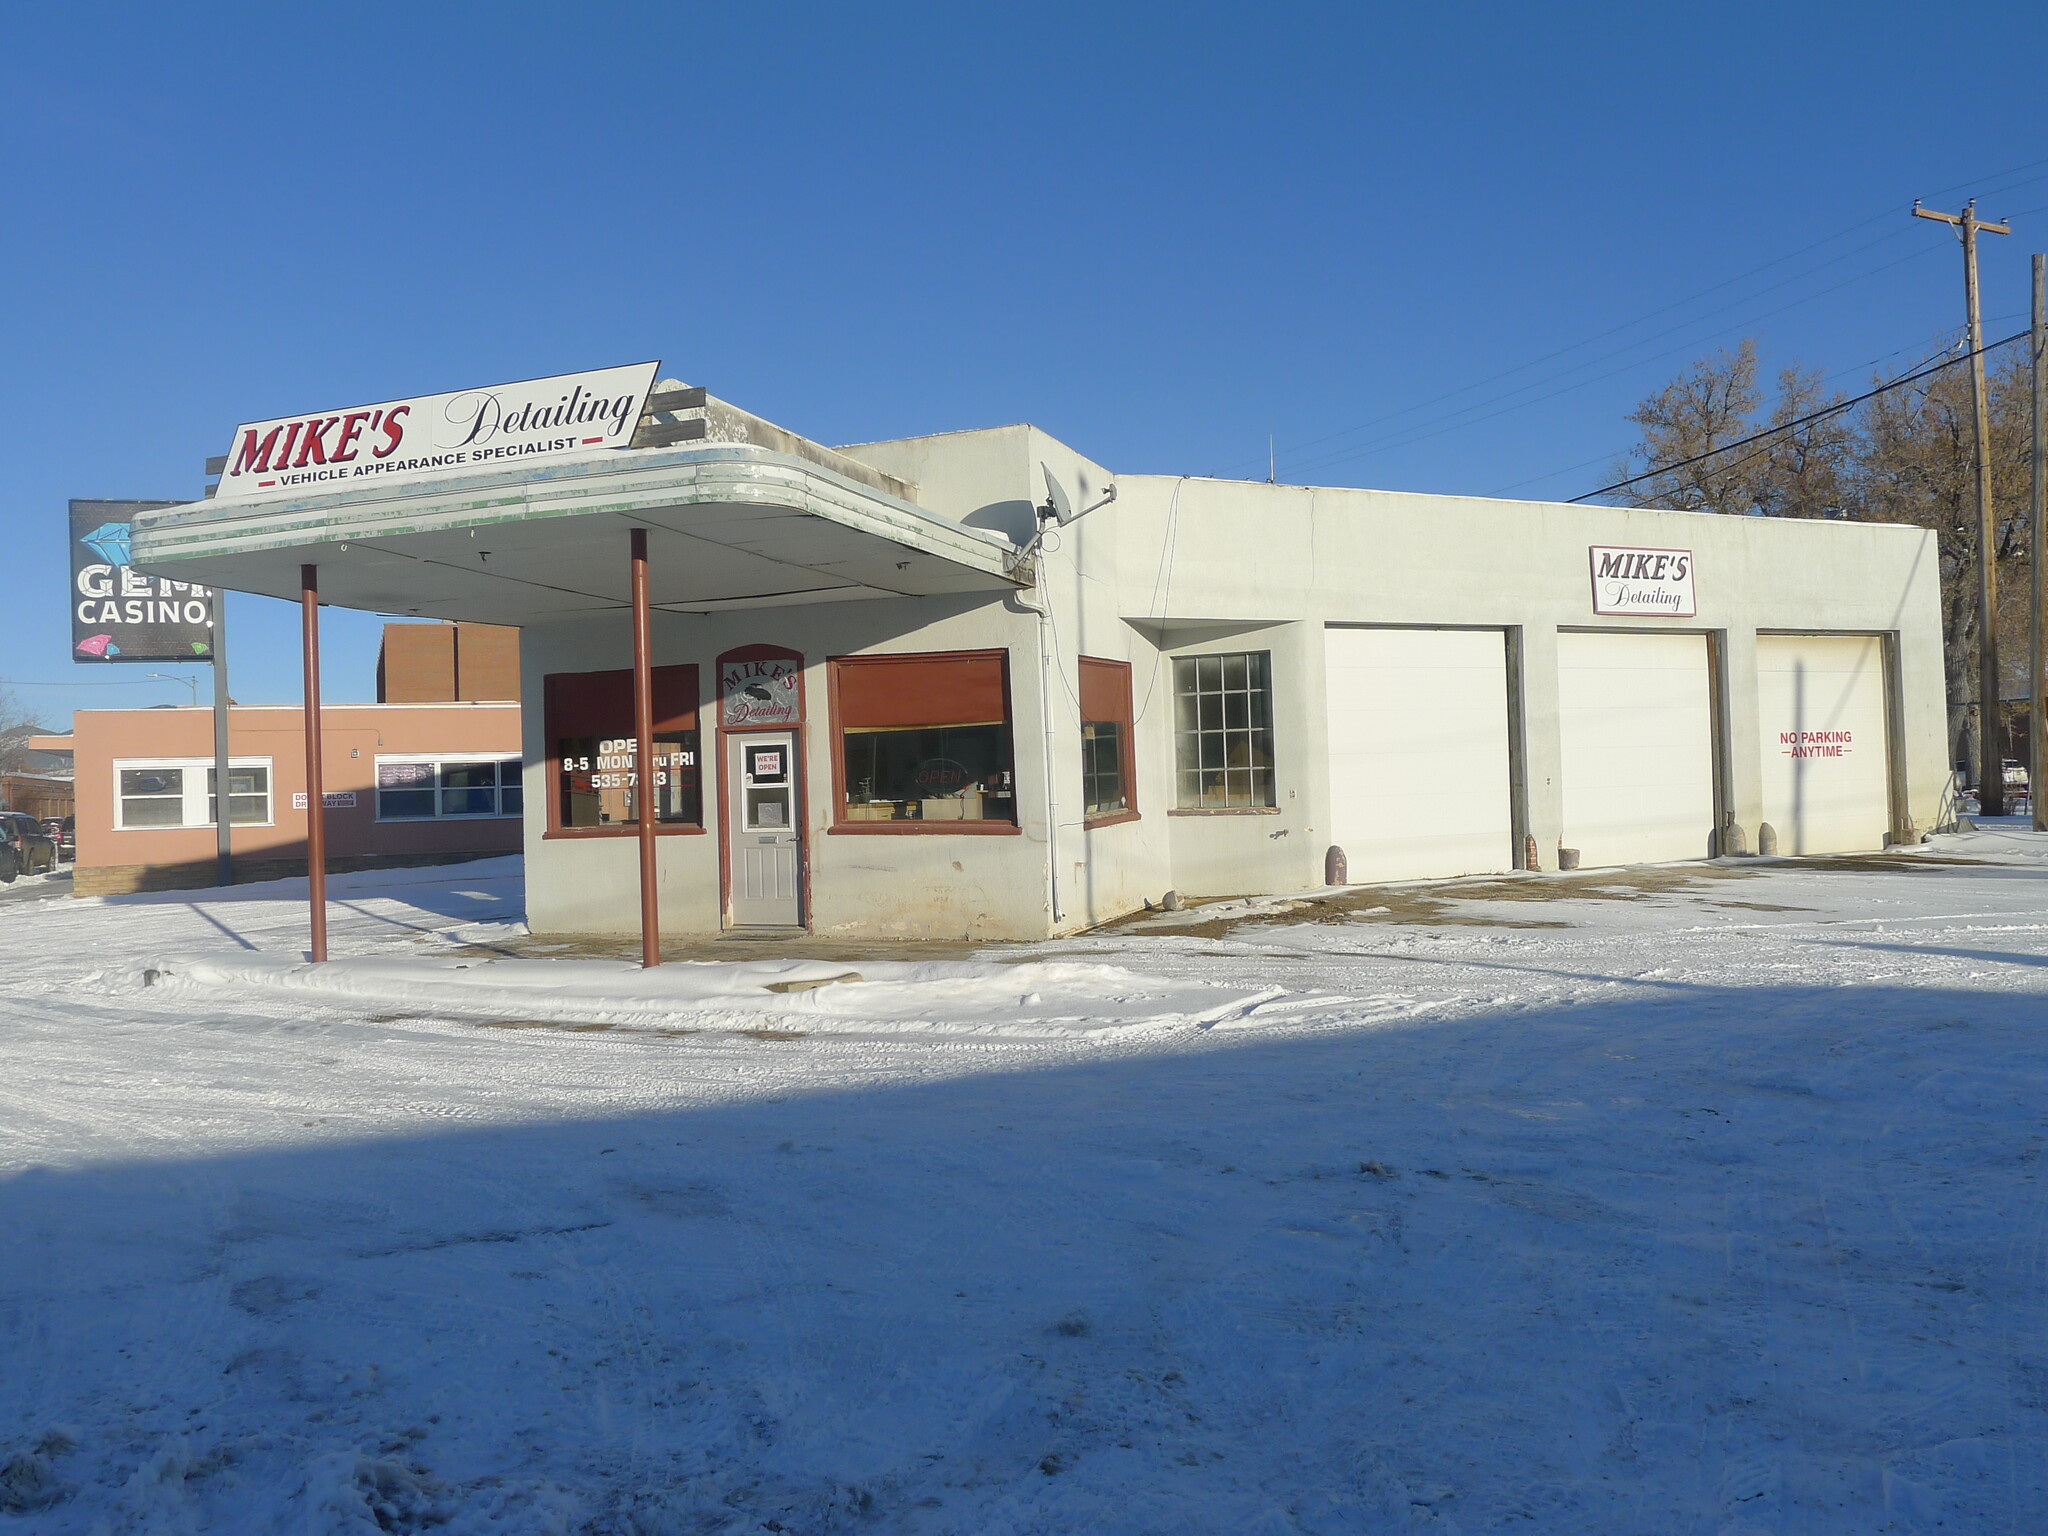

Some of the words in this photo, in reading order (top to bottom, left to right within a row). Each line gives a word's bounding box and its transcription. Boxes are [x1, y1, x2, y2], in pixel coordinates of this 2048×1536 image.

[230, 405, 410, 477] MIKE'S
[434, 385, 635, 449] Detailing
[280, 468, 348, 486] VEHICLE
[353, 452, 466, 477] APPEARANCE
[471, 437, 577, 461] SPECIALIST
[1597, 553, 1689, 581] MIKE'S
[1602, 581, 1682, 612] Detailing
[77, 600, 206, 624] CASINO
[723, 662, 797, 691] MIKE'S
[728, 702, 793, 725] Detailing
[600, 738, 637, 754] OPE
[1780, 732, 1798, 744] NO
[1801, 731, 1852, 743] PARKING
[564, 757, 589, 771] 8-5
[597, 754, 633, 770] MON
[652, 756, 667, 767] ru
[670, 752, 694, 766] FRI
[1791, 745, 1843, 758] ANYTIME
[758, 763, 777, 771] OPEN
[918, 769, 961, 784] OPEN
[591, 772, 667, 788] 535-73
